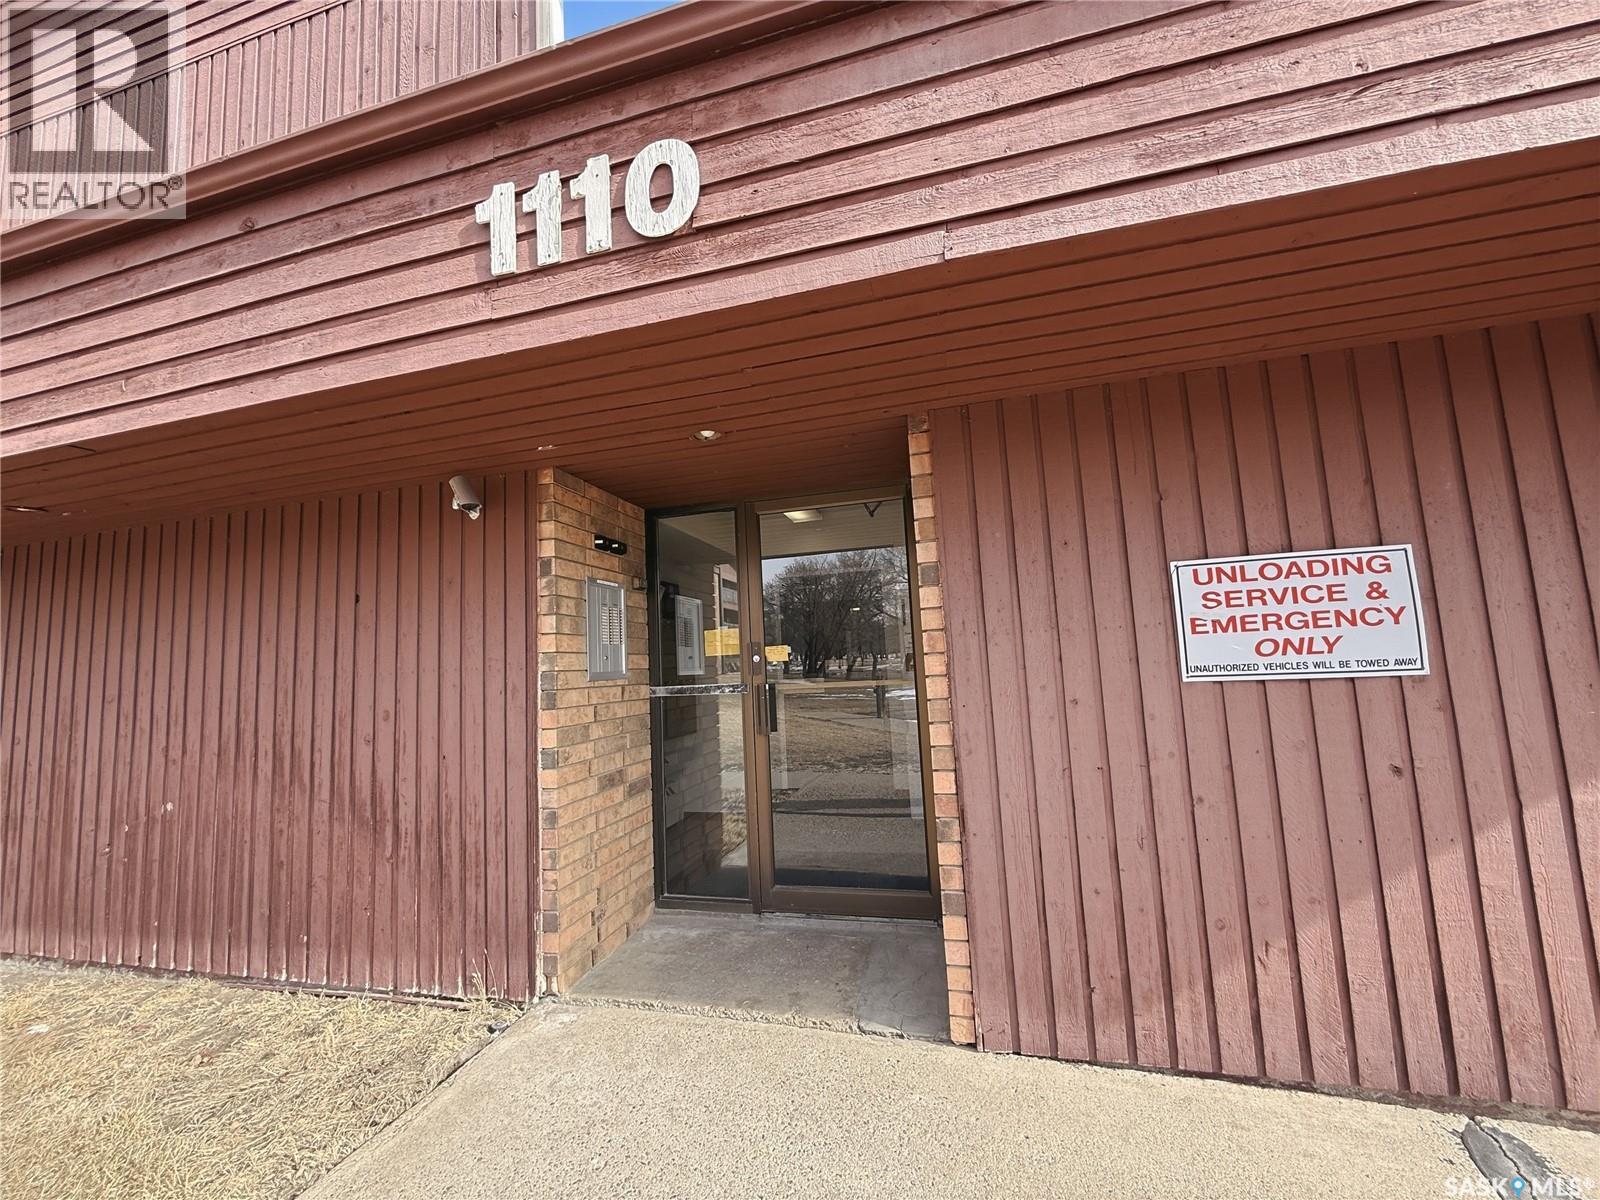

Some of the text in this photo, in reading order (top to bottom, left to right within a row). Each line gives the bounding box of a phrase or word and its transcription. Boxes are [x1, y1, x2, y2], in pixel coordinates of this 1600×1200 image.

[474, 138, 700, 277] 1110
[1192, 554, 1392, 586] UNLOADING
[1201, 581, 1390, 609] SERVICE &
[1190, 606, 1406, 635] EMERGENCY
[1254, 635, 1344, 657] ONLY
[1189, 657, 1419, 674] UNAUTHORIZED VEHICLES WILL BE TOWED AWAY
